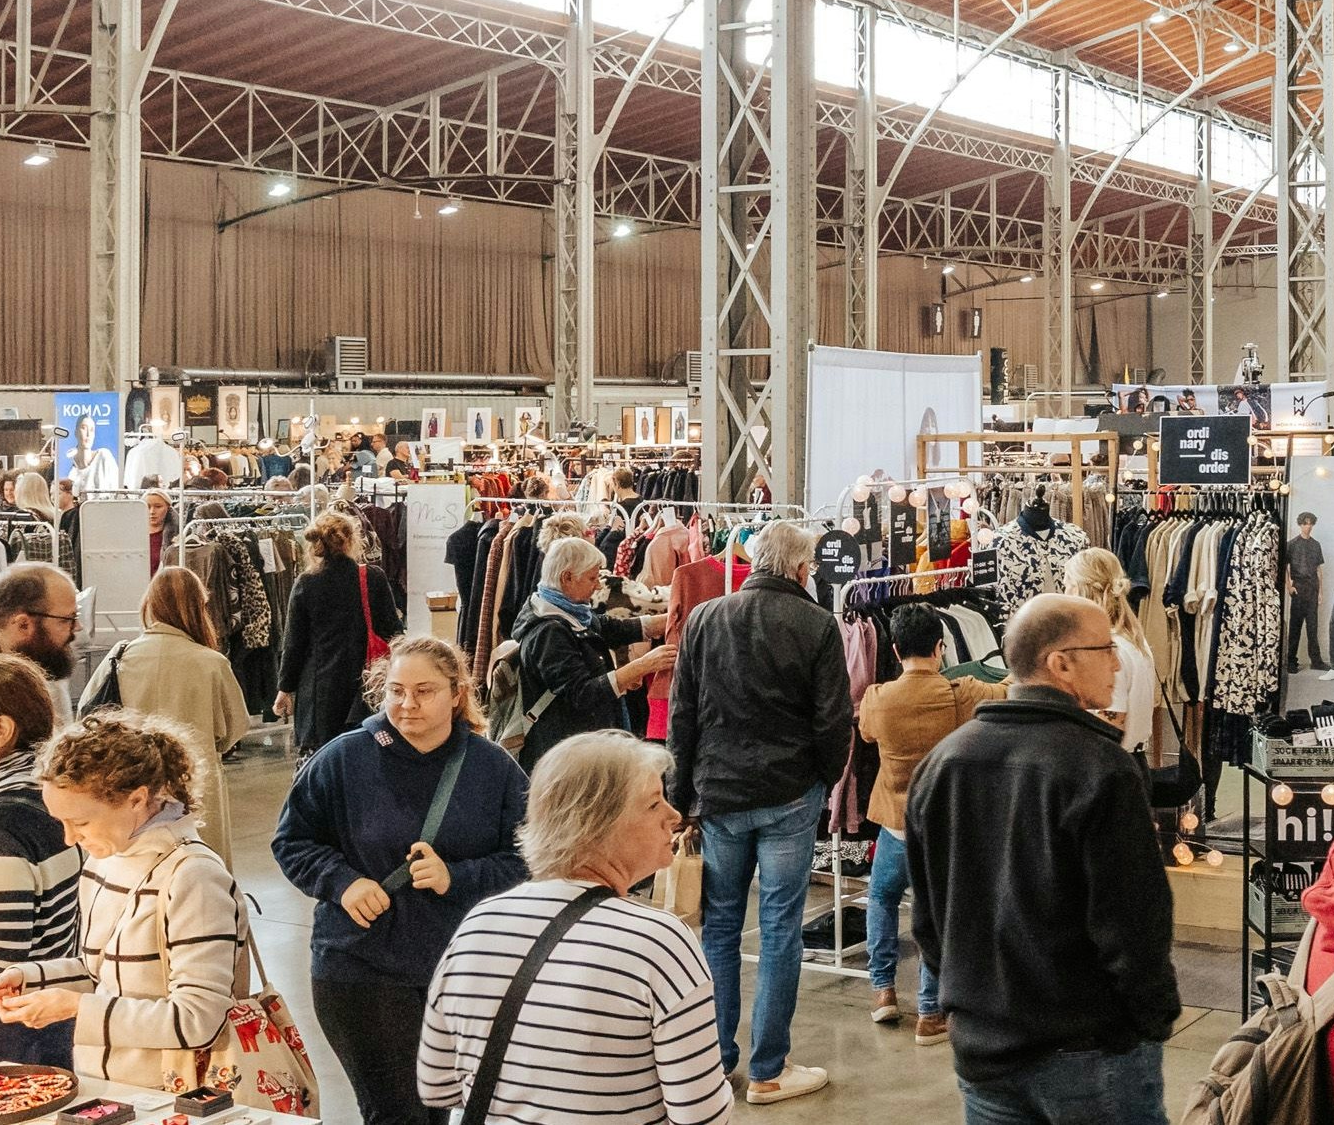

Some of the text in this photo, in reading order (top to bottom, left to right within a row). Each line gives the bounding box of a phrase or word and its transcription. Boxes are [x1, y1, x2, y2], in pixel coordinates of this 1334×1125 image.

[1186, 427, 1210, 439] ordi
[1179, 439, 1206, 451] nary
[1210, 448, 1229, 461] dis
[1198, 461, 1231, 474] order
[826, 540, 842, 548] ordi
[822, 548, 839, 557] nary
[841, 555, 854, 564] dis
[834, 564, 855, 573] order
[1277, 807, 1333, 842] hi!
